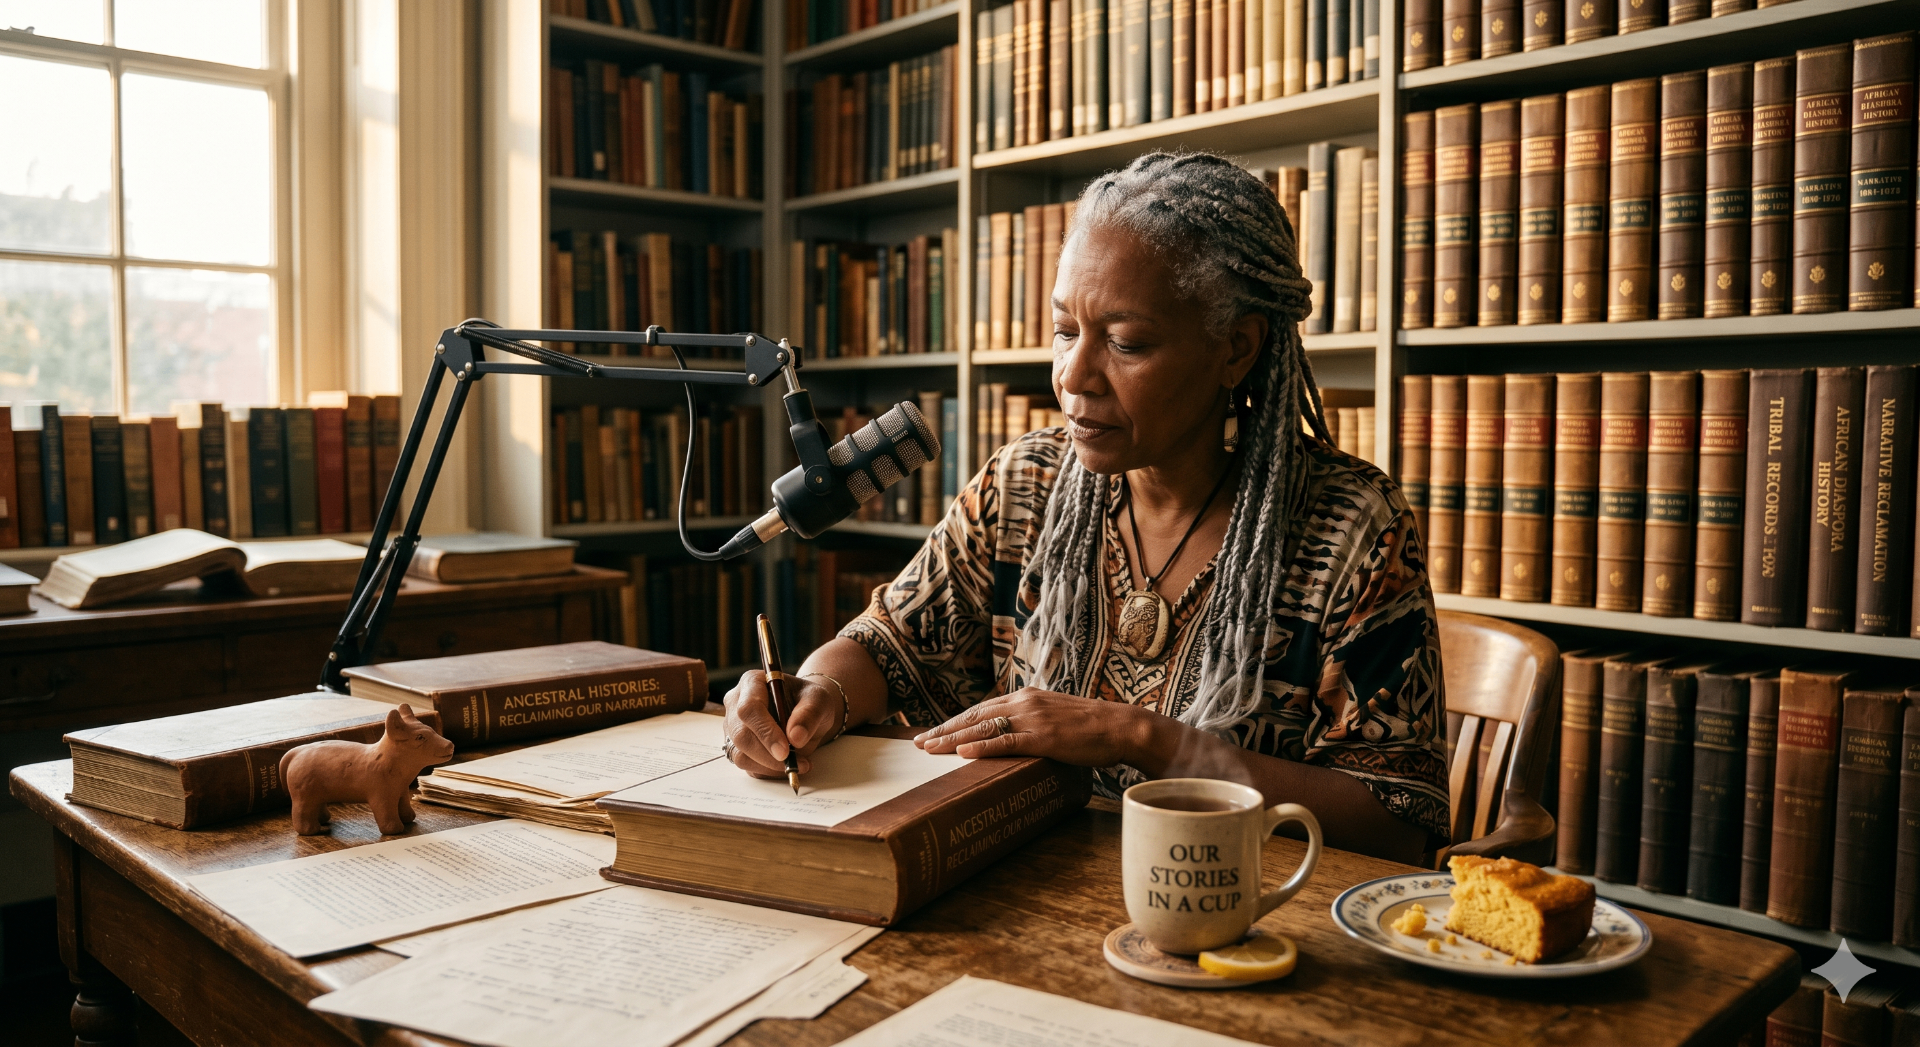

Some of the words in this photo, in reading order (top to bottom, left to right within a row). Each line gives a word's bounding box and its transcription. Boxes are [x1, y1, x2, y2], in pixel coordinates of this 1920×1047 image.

[1768, 397, 1784, 456] TRIBAL
[1835, 406, 1850, 471] AFRICAN
[1879, 398, 1896, 478] NARRATIVE
[1764, 461, 1781, 536] RECORDS
[1816, 461, 1831, 527] HISTORY
[1831, 477, 1847, 553] DIASPORA
[1873, 482, 1892, 583] RECLAMATION
[500, 706, 574, 727] RECLAIMING
[577, 702, 602, 716] OUR
[605, 693, 667, 713] NARRATIVE
[504, 687, 585, 710] ANCESTRAL
[588, 678, 660, 699] HISTORIES:
[946, 830, 1001, 872] RECLAIMING
[1003, 818, 1022, 839] OUR
[1023, 794, 1065, 830] NARRATIVE
[950, 801, 1009, 847] ANCESTRAL
[1009, 775, 1060, 814] HISTORIES:
[1150, 866, 1239, 888] STORIES
[1170, 844, 1221, 863] OUR
[1148, 890, 1170, 910] IN
[1176, 895, 1192, 912] A
[1198, 892, 1242, 913] CUP
